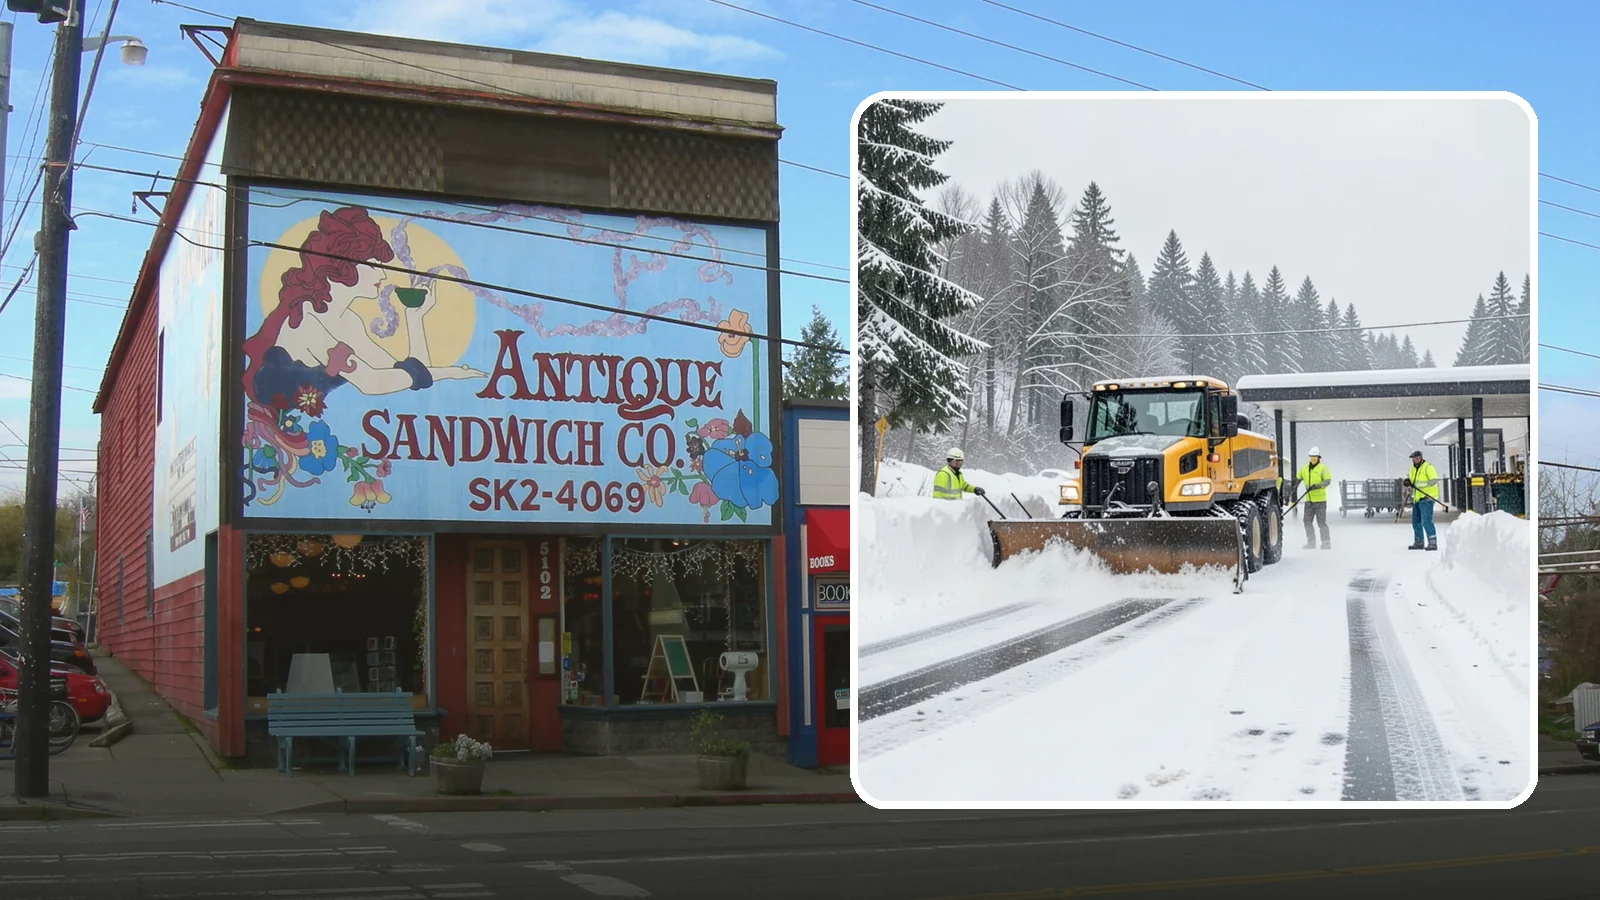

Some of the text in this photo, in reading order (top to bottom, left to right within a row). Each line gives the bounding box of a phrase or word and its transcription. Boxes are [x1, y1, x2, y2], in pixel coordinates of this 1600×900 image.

[475, 328, 723, 420] ANTIQUE
[362, 408, 684, 468] SANDWICH CO.
[469, 478, 646, 512] SK2-4069
[540, 543, 551, 600] 5102
[810, 556, 834, 569] BOOKS
